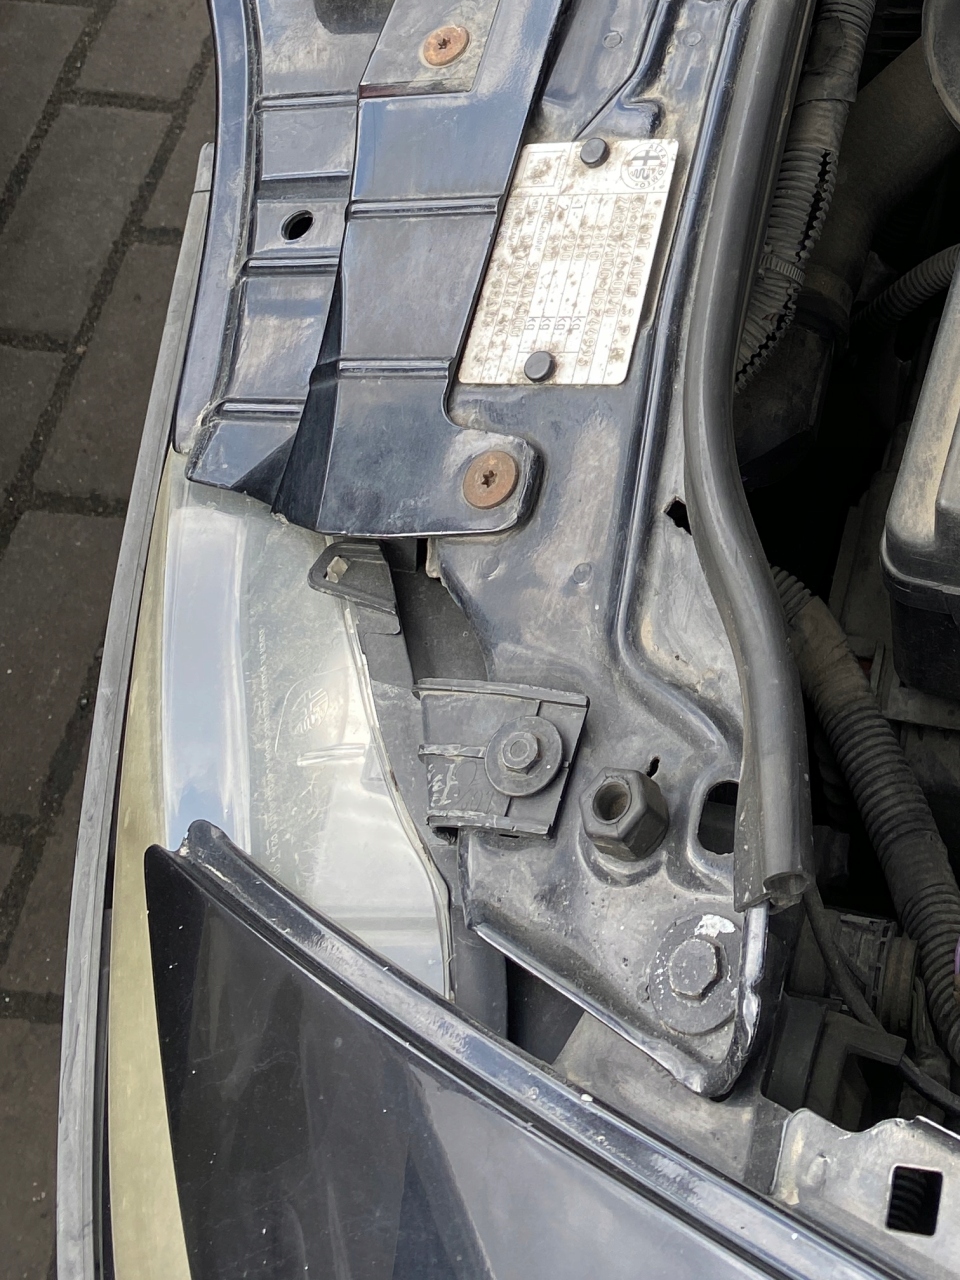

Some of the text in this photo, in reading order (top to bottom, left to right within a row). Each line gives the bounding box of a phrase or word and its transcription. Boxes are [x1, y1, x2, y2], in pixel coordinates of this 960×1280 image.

[645, 143, 669, 159] ALFA
[524, 316, 540, 330] kg
[538, 316, 556, 331] kg
[554, 315, 571, 331] kg
[569, 316, 586, 331] kg
